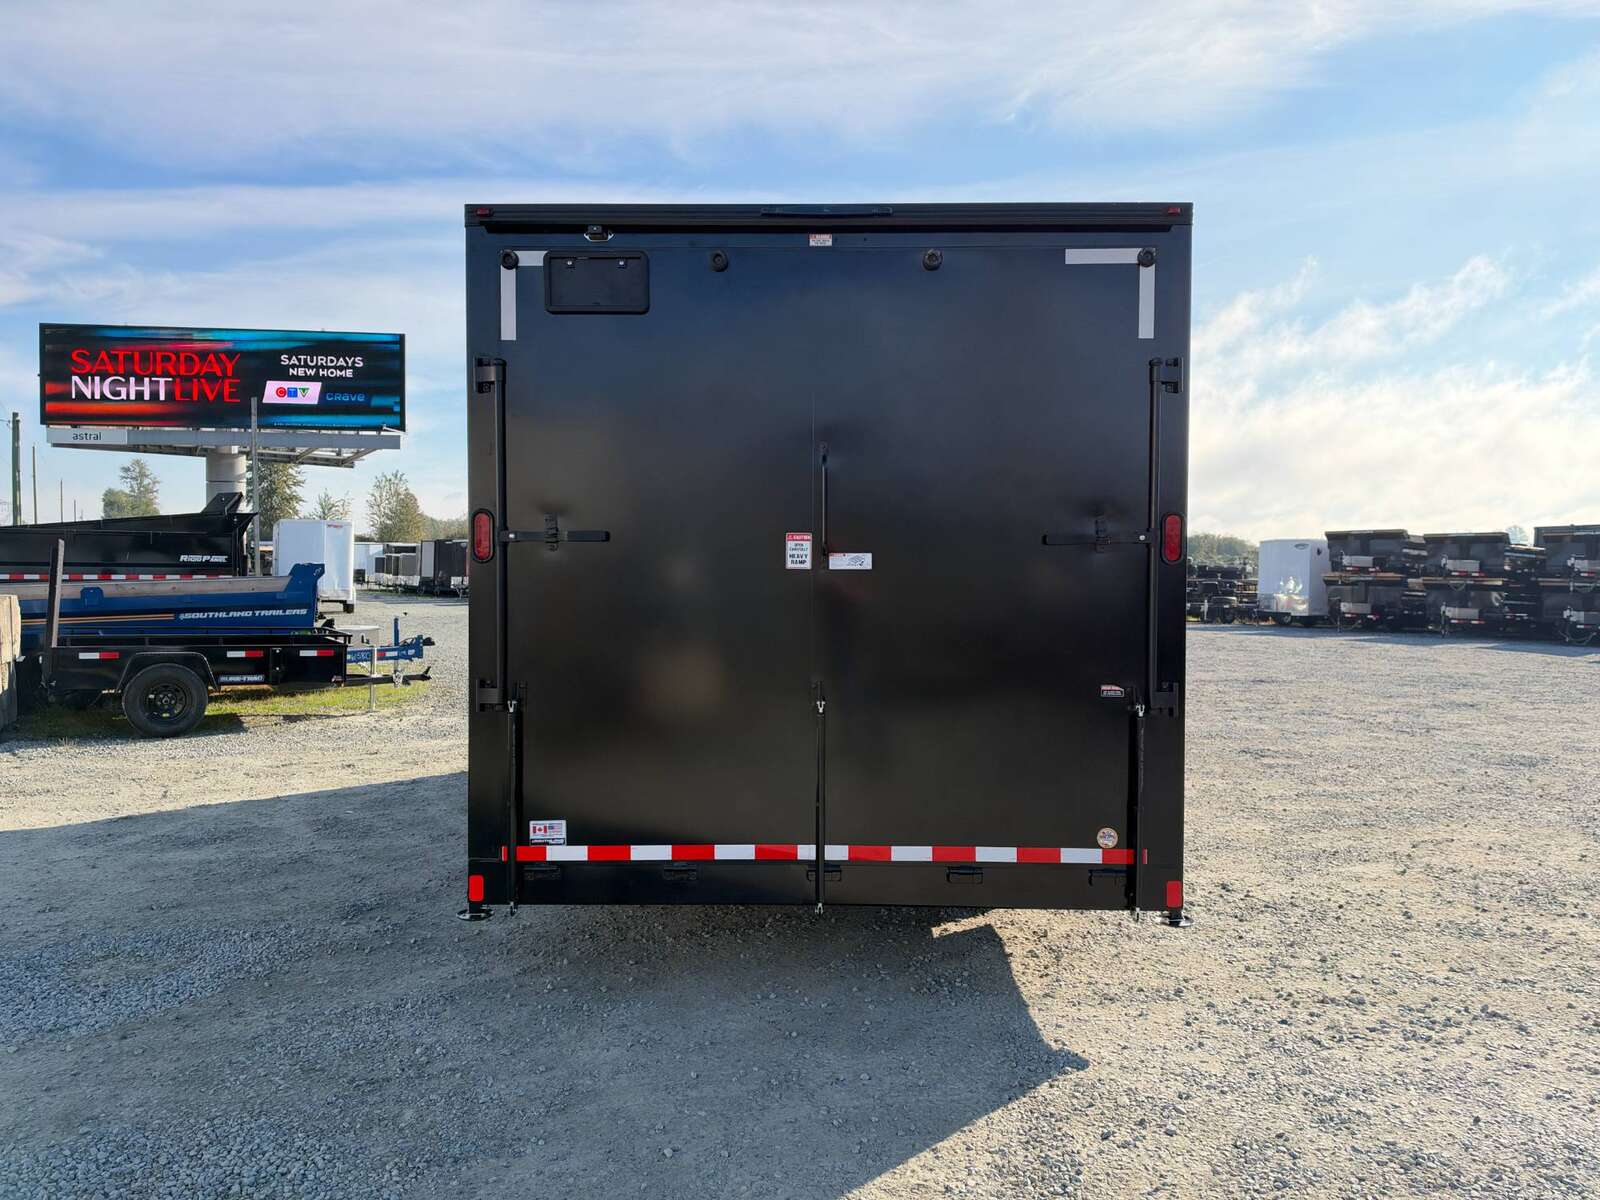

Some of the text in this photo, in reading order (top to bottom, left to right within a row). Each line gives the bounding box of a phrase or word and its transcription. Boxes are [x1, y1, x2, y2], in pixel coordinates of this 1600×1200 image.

[71, 348, 240, 377] SATURDAY
[280, 354, 364, 367] SATURDAYS
[289, 367, 353, 378] NEW HOME
[71, 375, 240, 403] NIGHT LIVE
[275, 386, 310, 398] CTV
[72, 432, 102, 441] astral
[184, 608, 308, 619] SOUTHLAND TRAILERS
